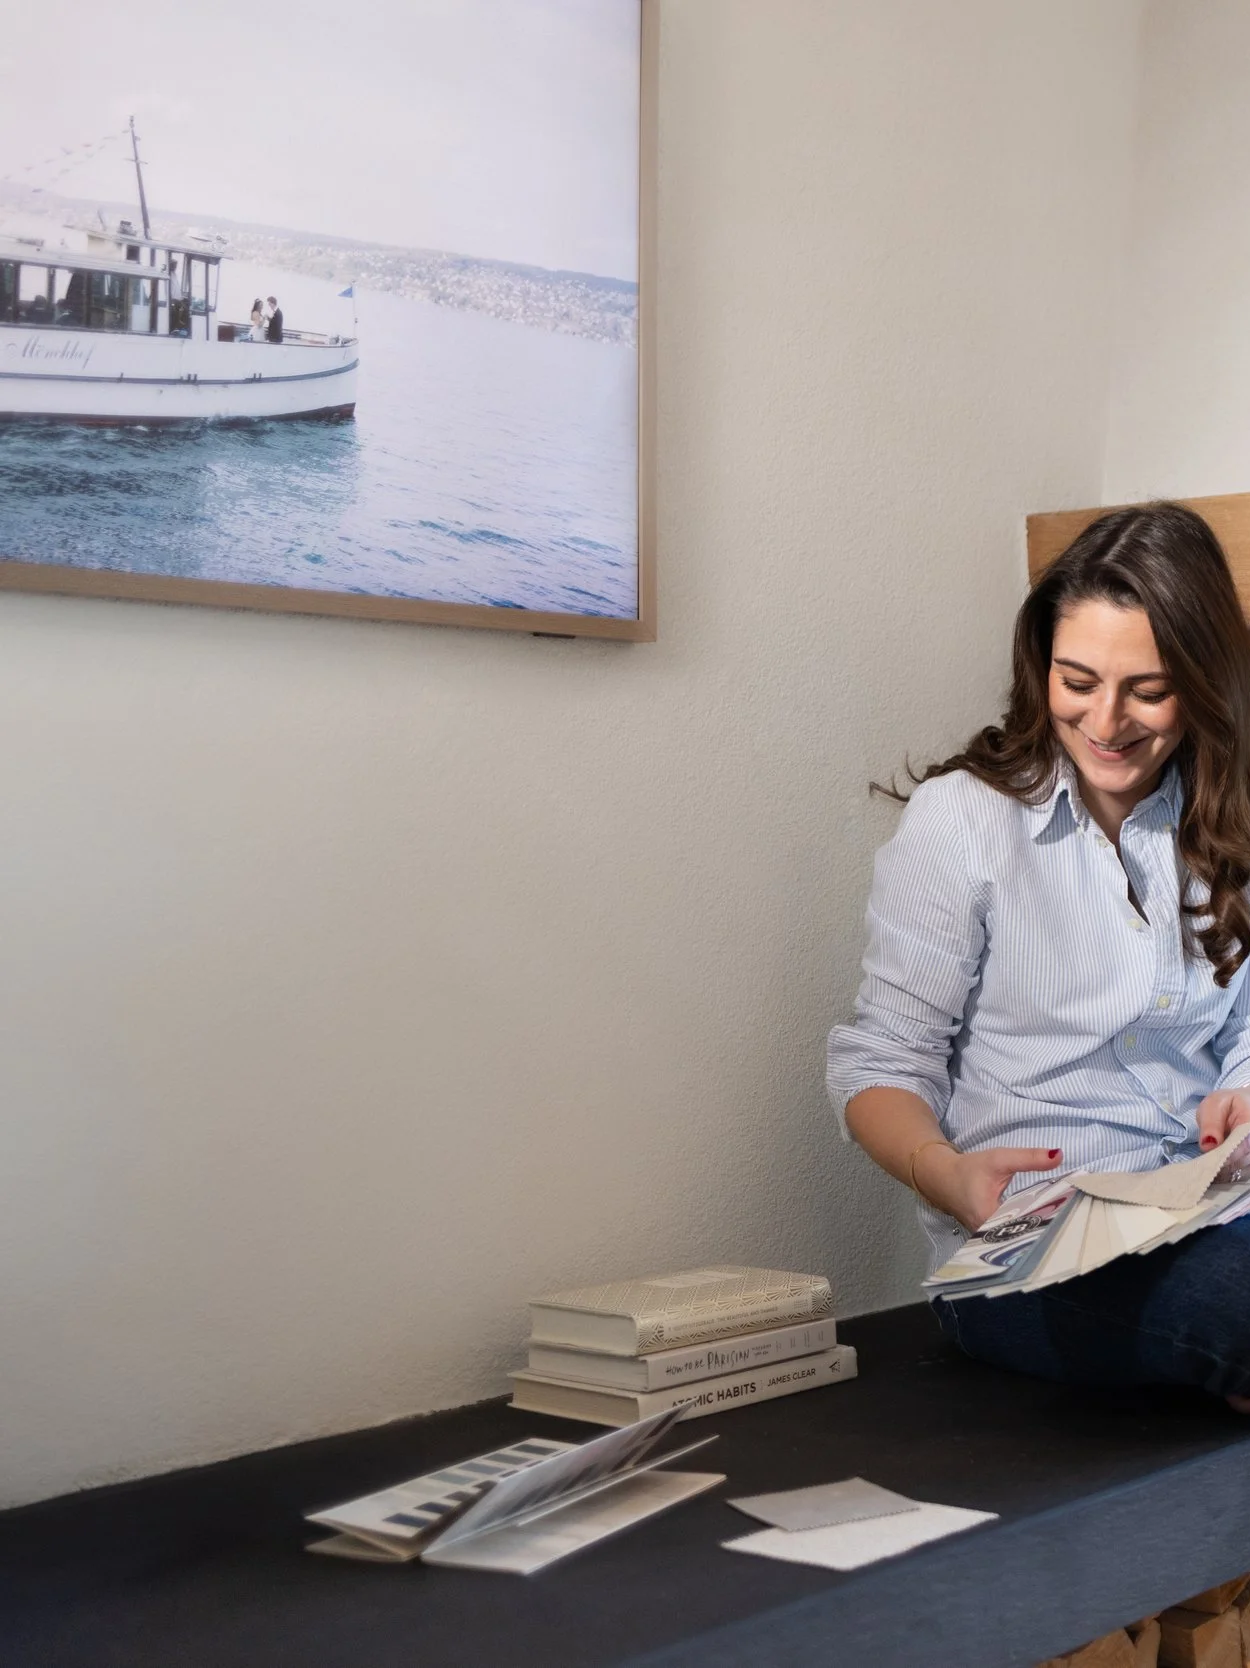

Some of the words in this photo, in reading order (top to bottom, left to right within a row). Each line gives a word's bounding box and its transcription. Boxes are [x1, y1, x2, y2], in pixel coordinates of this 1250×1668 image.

[717, 1382, 757, 1402] HABITS
[767, 1374, 791, 1387] JAMES
[792, 1368, 816, 1381] CLEAR
